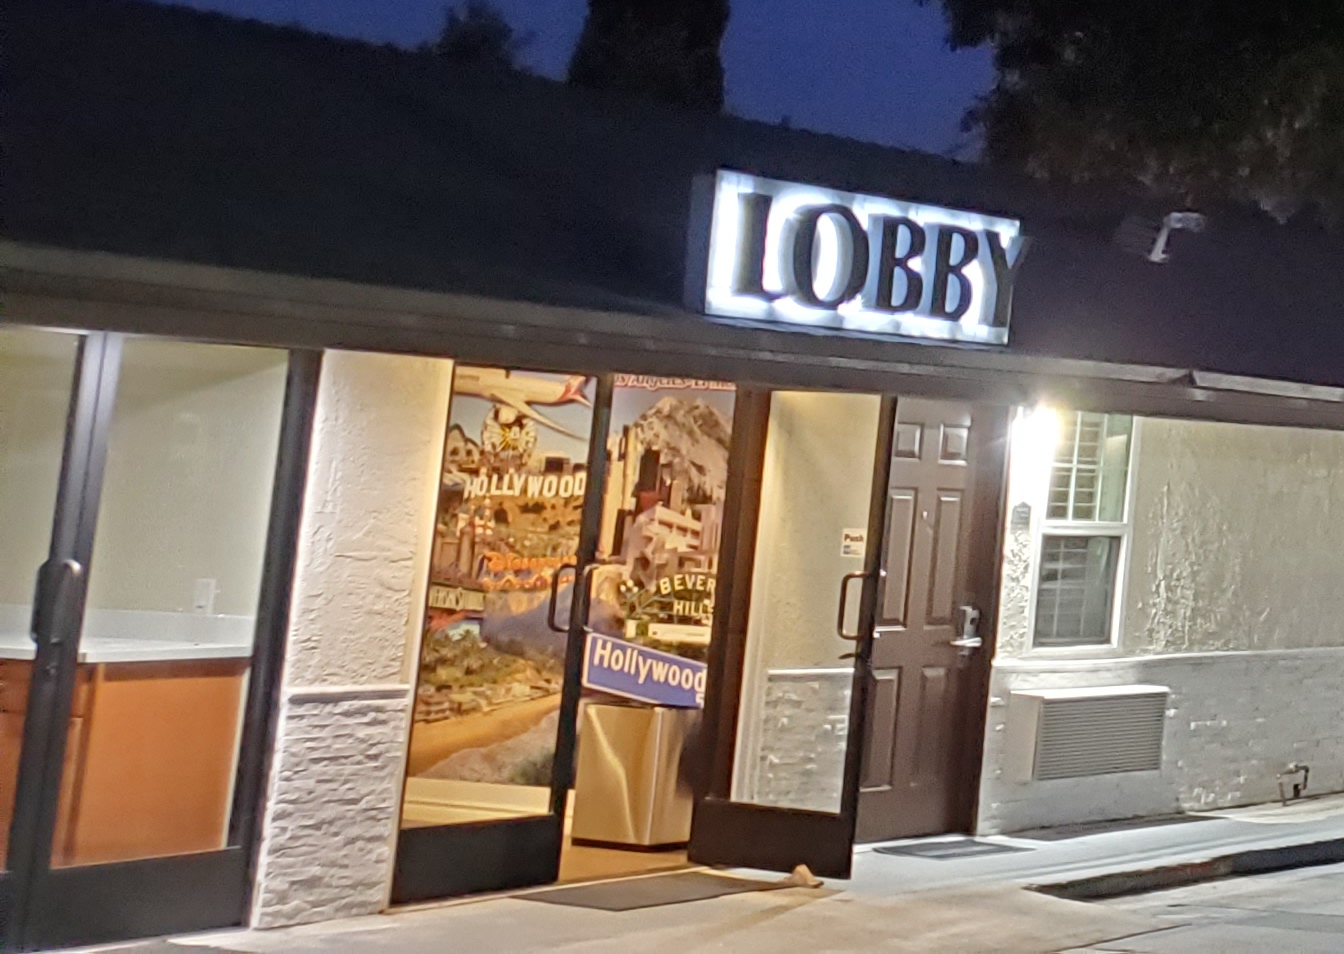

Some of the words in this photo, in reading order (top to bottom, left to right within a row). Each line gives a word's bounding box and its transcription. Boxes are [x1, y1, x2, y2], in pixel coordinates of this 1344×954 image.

[734, 191, 1032, 328] LOBBY
[463, 471, 587, 499] HOLLYWOOD
[844, 533, 864, 542] Push
[593, 638, 707, 693] Hollywood
